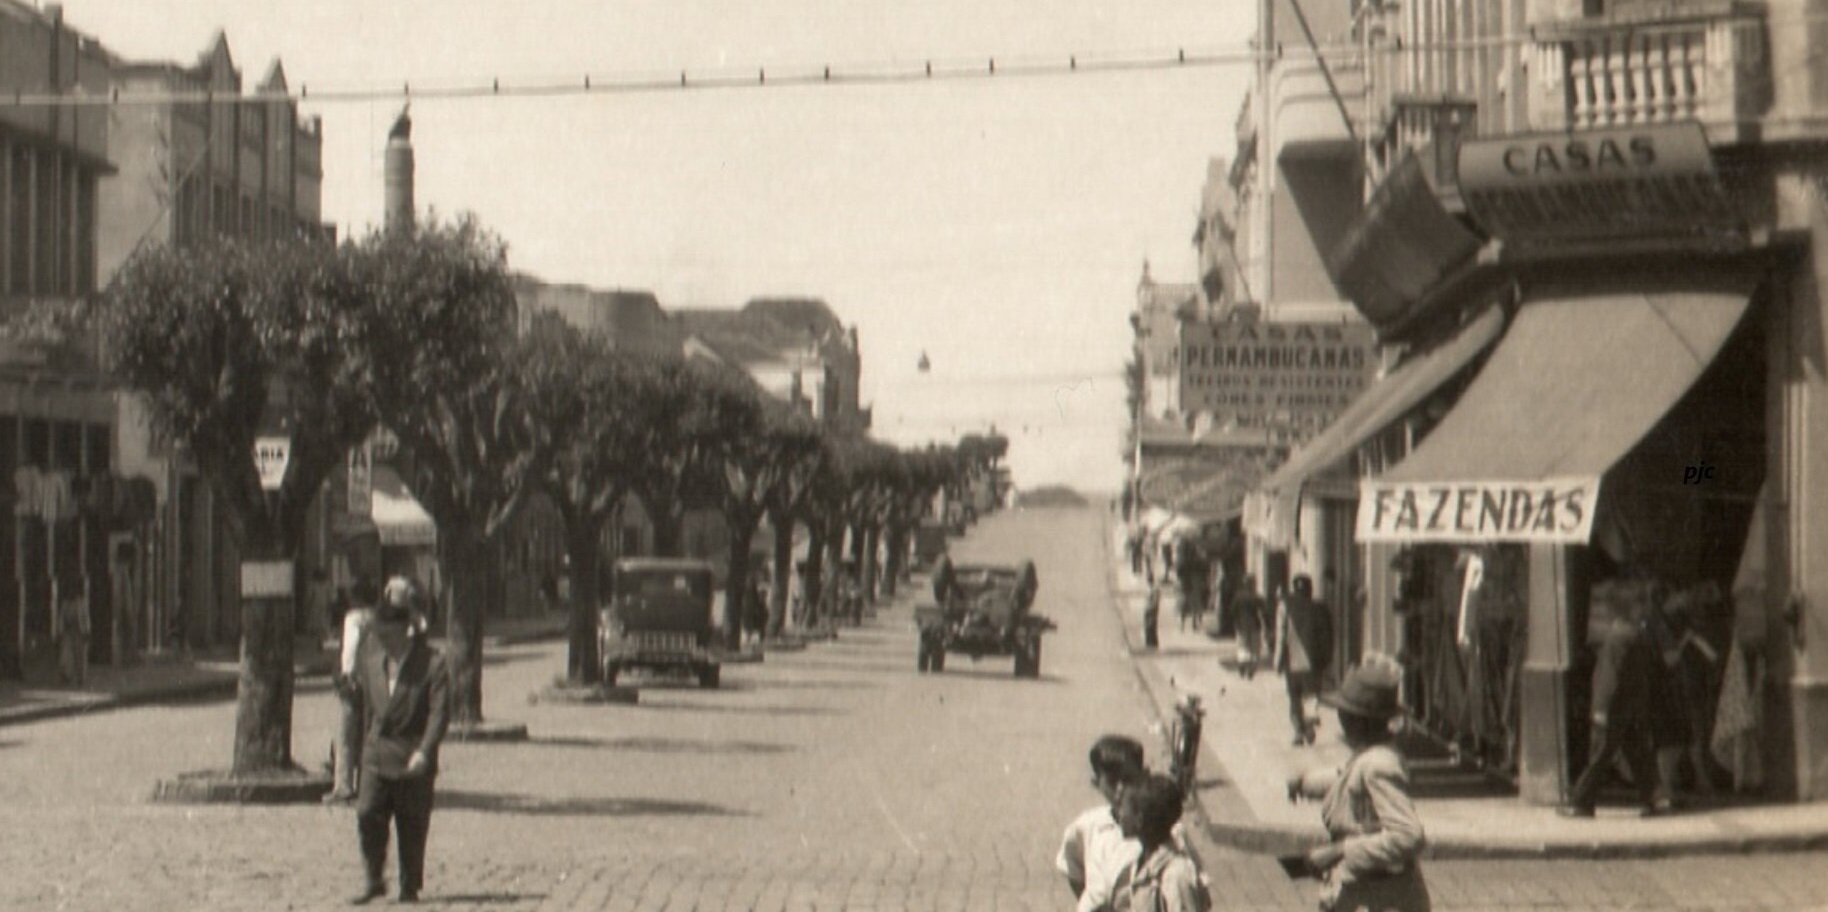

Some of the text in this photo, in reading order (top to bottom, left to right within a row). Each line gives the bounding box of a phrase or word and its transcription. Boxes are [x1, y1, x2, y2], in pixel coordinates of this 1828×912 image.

[1503, 136, 1655, 175] CASAS
[1211, 325, 1342, 342] CASAS
[1187, 345, 1365, 368] PERNAMBUCANAS
[1372, 487, 1585, 533] FAZENDAS
